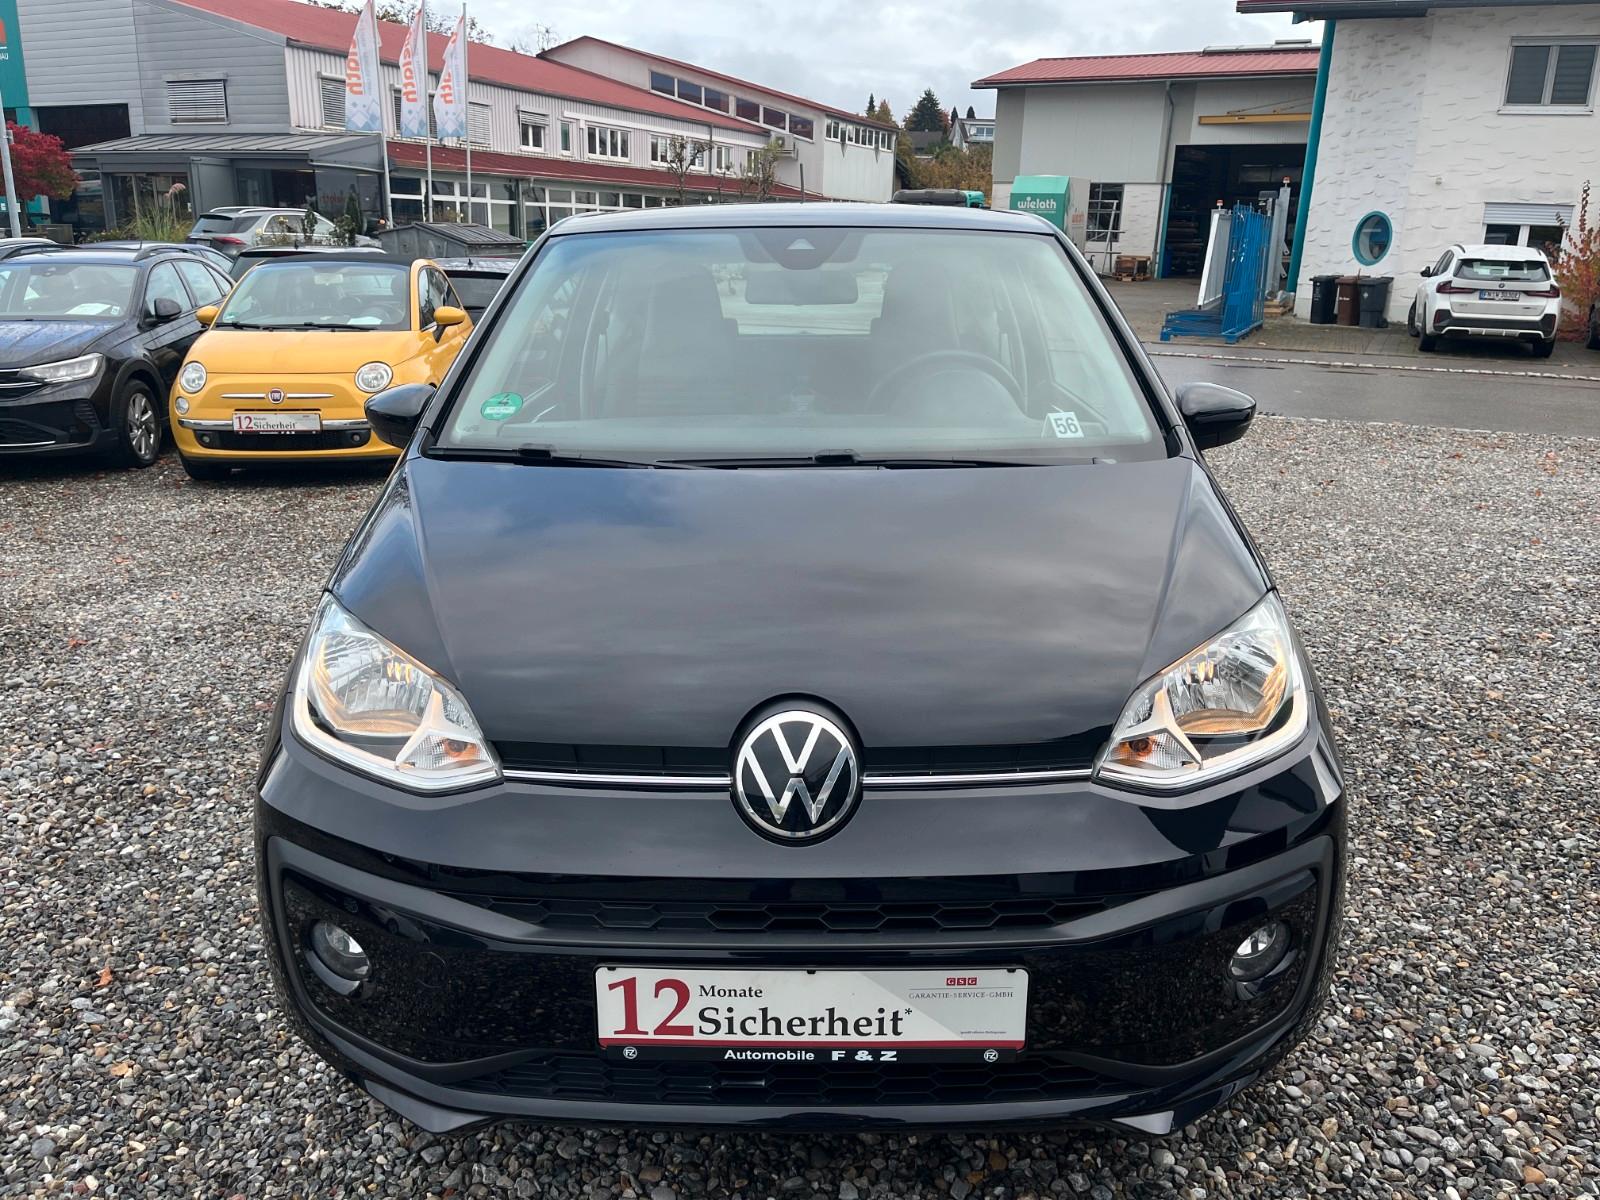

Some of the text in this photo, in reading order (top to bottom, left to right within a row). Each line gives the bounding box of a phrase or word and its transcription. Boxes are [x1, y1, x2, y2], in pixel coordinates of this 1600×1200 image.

[1017, 196, 1057, 208] wielath
[235, 415, 253, 429] 12
[1054, 417, 1078, 435] 56
[946, 977, 978, 986] GSG
[698, 984, 763, 997] Monate
[608, 976, 694, 1037] 12
[724, 1049, 897, 1061] Automobile F & Z
